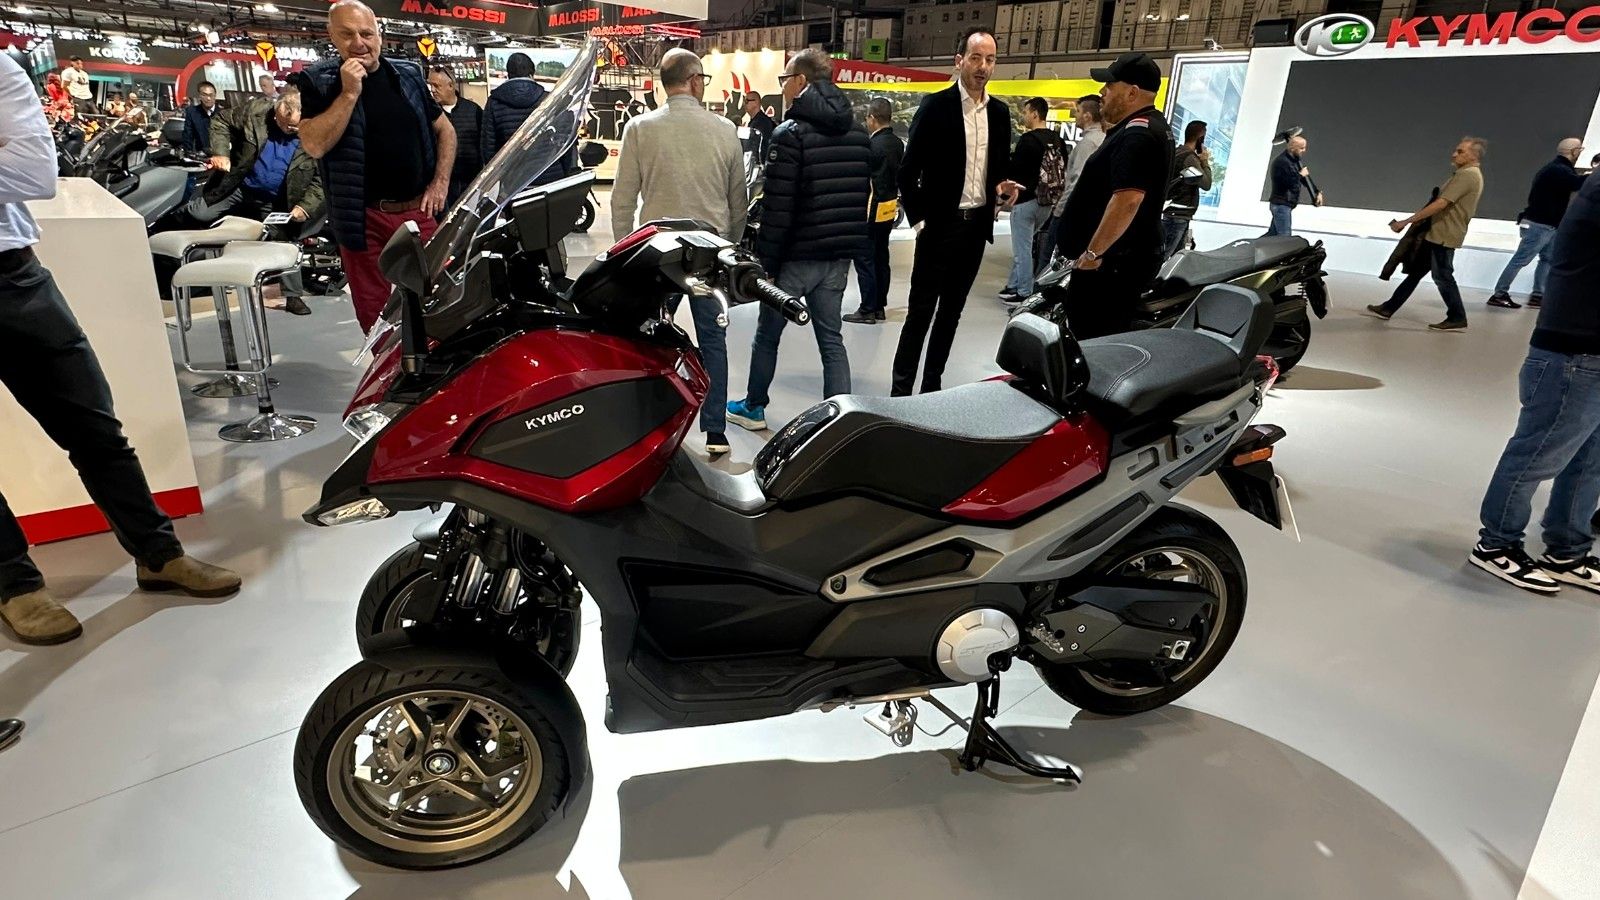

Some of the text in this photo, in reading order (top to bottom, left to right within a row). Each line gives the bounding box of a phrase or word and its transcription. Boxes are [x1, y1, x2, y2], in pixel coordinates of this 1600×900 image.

[548, 8, 600, 27] MALOSSI
[1386, 5, 1600, 49] KYMCO
[436, 43, 477, 58] YADEA
[525, 404, 585, 430] KYMCO
